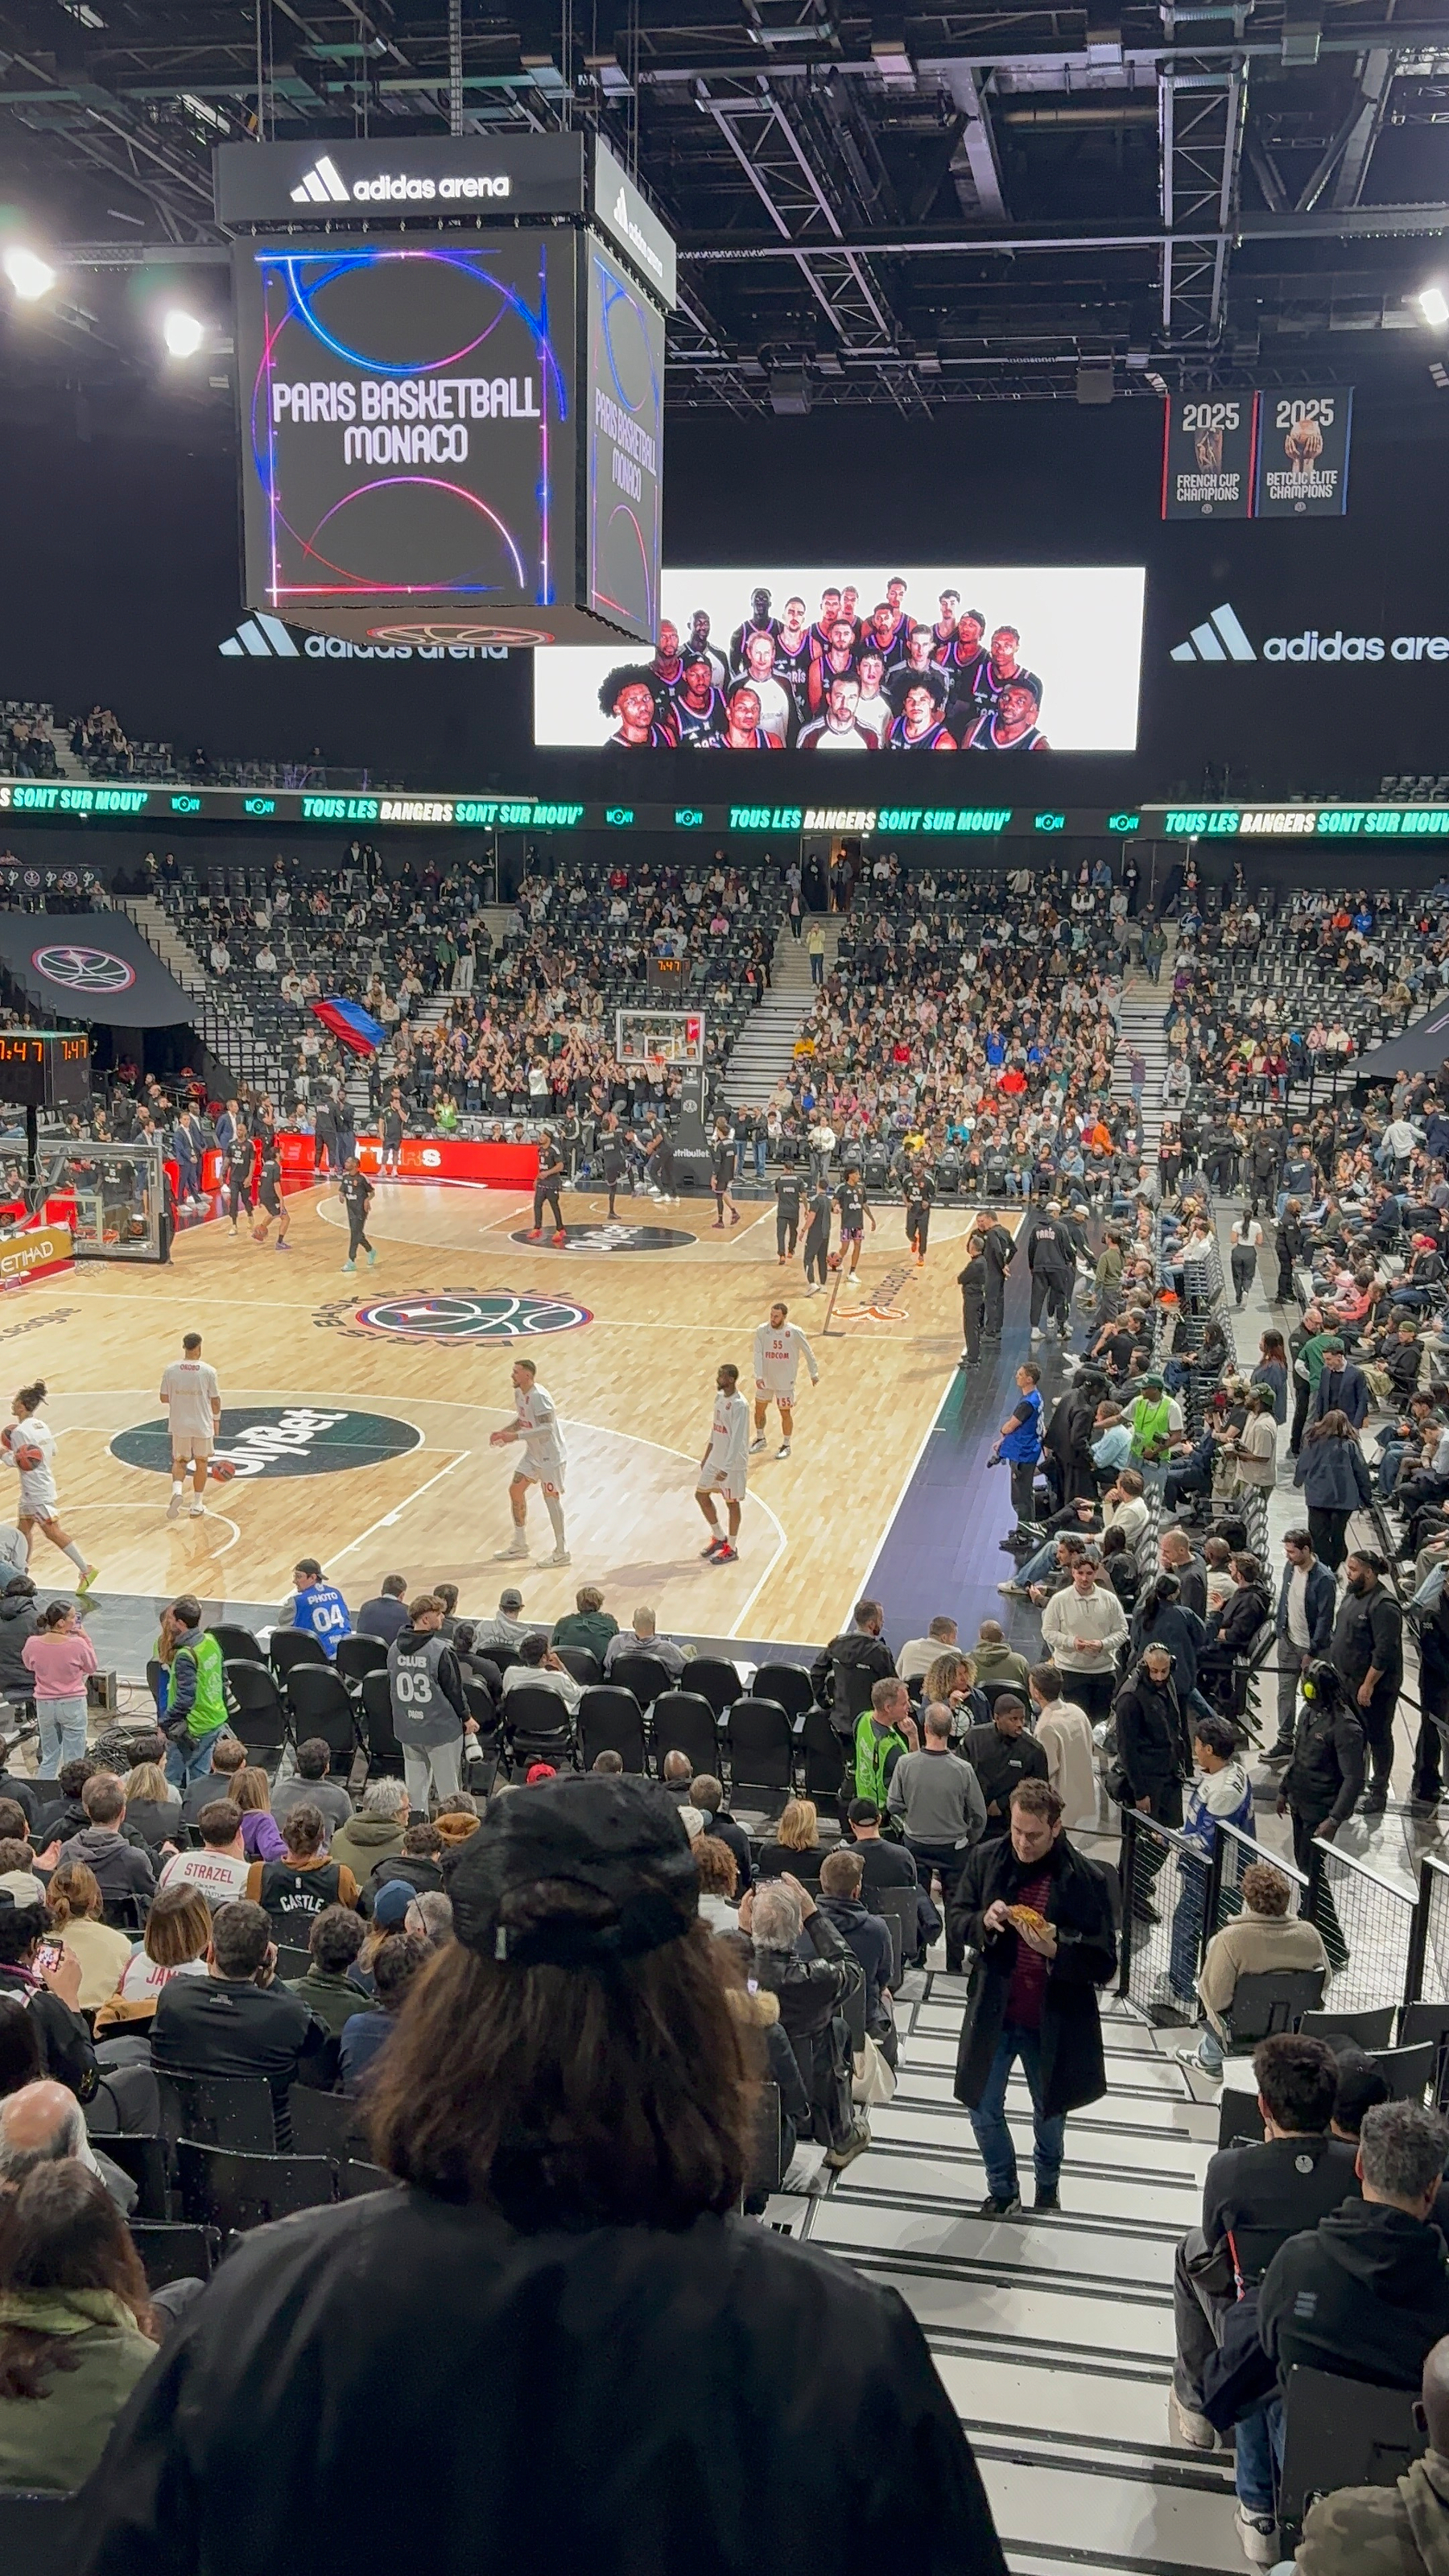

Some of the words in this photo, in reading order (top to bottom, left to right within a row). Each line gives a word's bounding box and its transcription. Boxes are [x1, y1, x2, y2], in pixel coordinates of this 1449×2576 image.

[353, 175, 436, 200] adidas
[438, 176, 510, 198] arena
[272, 381, 357, 423] PARIS
[361, 377, 541, 422] BASKETBALL
[1182, 402, 1241, 431] 2025
[1275, 398, 1335, 428] 2025
[344, 423, 469, 464] MONACO
[595, 386, 618, 442] PARIS
[617, 407, 657, 477] BASKETBALL
[612, 446, 642, 503] MONACO
[1176, 473, 1217, 489] FRENCH
[1219, 473, 1241, 487] CUP
[1266, 472, 1308, 486] BETCLIC
[1310, 469, 1338, 485] ÉLITE
[1176, 487, 1240, 502] CHAMPIONS
[1269, 485, 1333, 500] CHAMPIONS
[304, 635, 415, 659] adidas
[1263, 631, 1385, 662] adidas
[13, 787, 59, 808] SONT
[60, 791, 94, 810] SUR
[95, 791, 148, 811] MOUV'
[303, 799, 346, 819] TOUS
[348, 800, 378, 819] LES
[380, 802, 453, 822] BANGERS
[456, 803, 499, 824] SONT
[499, 805, 532, 824] SUR
[533, 806, 584, 825] MOUV'
[730, 809, 771, 828] TOUS
[771, 810, 803, 829] LES
[803, 811, 877, 831] BANGERS
[877, 811, 923, 830] SONT
[923, 811, 956, 831] SUR
[956, 812, 1011, 832] MOUV'
[1166, 813, 1208, 832] TOUS
[1208, 813, 1240, 832] LES
[1240, 813, 1317, 833] BANGERS
[1317, 812, 1365, 832] SONT
[1364, 812, 1401, 832] SUR
[657, 960, 681, 972] 7:47
[60, 1038, 87, 1061] 7:47
[1, 1241, 54, 1274] ETIHAD
[773, 1340, 782, 1349] 55
[307, 1591, 339, 1605] PHOTO
[312, 1604, 345, 1633] 04
[397, 1655, 427, 1668] CLUB
[395, 1671, 433, 1703] 03
[184, 1862, 234, 1885] STRAZEL
[280, 1893, 324, 1913] CASTLE
